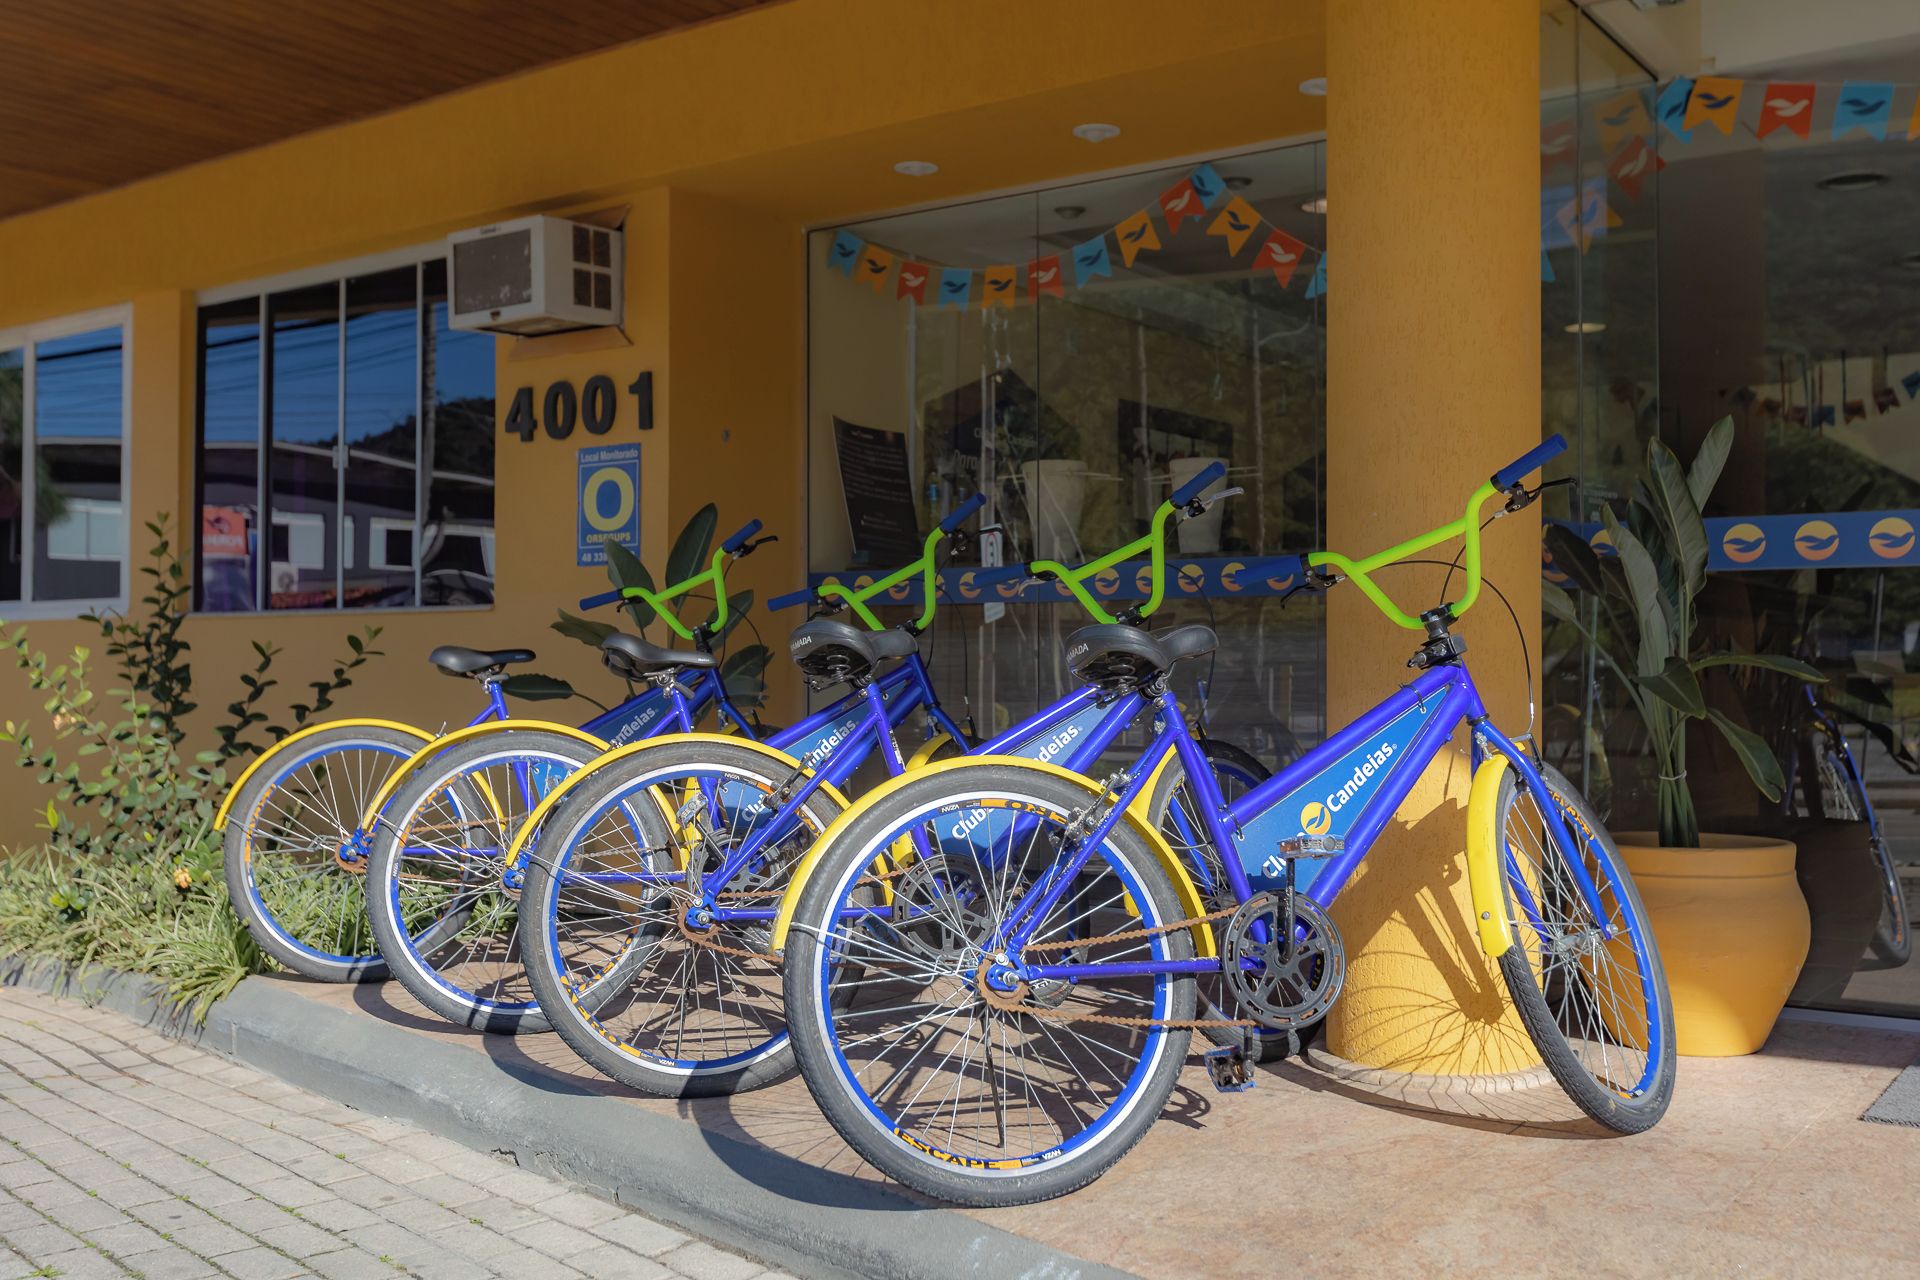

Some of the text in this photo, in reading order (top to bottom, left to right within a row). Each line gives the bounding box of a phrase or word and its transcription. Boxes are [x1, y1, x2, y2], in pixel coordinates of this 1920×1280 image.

[505, 371, 654, 442] 4001
[580, 451, 599, 463] Local
[583, 467, 635, 532] O
[1033, 725, 1079, 763] deias
[1325, 740, 1394, 813] Candeias
